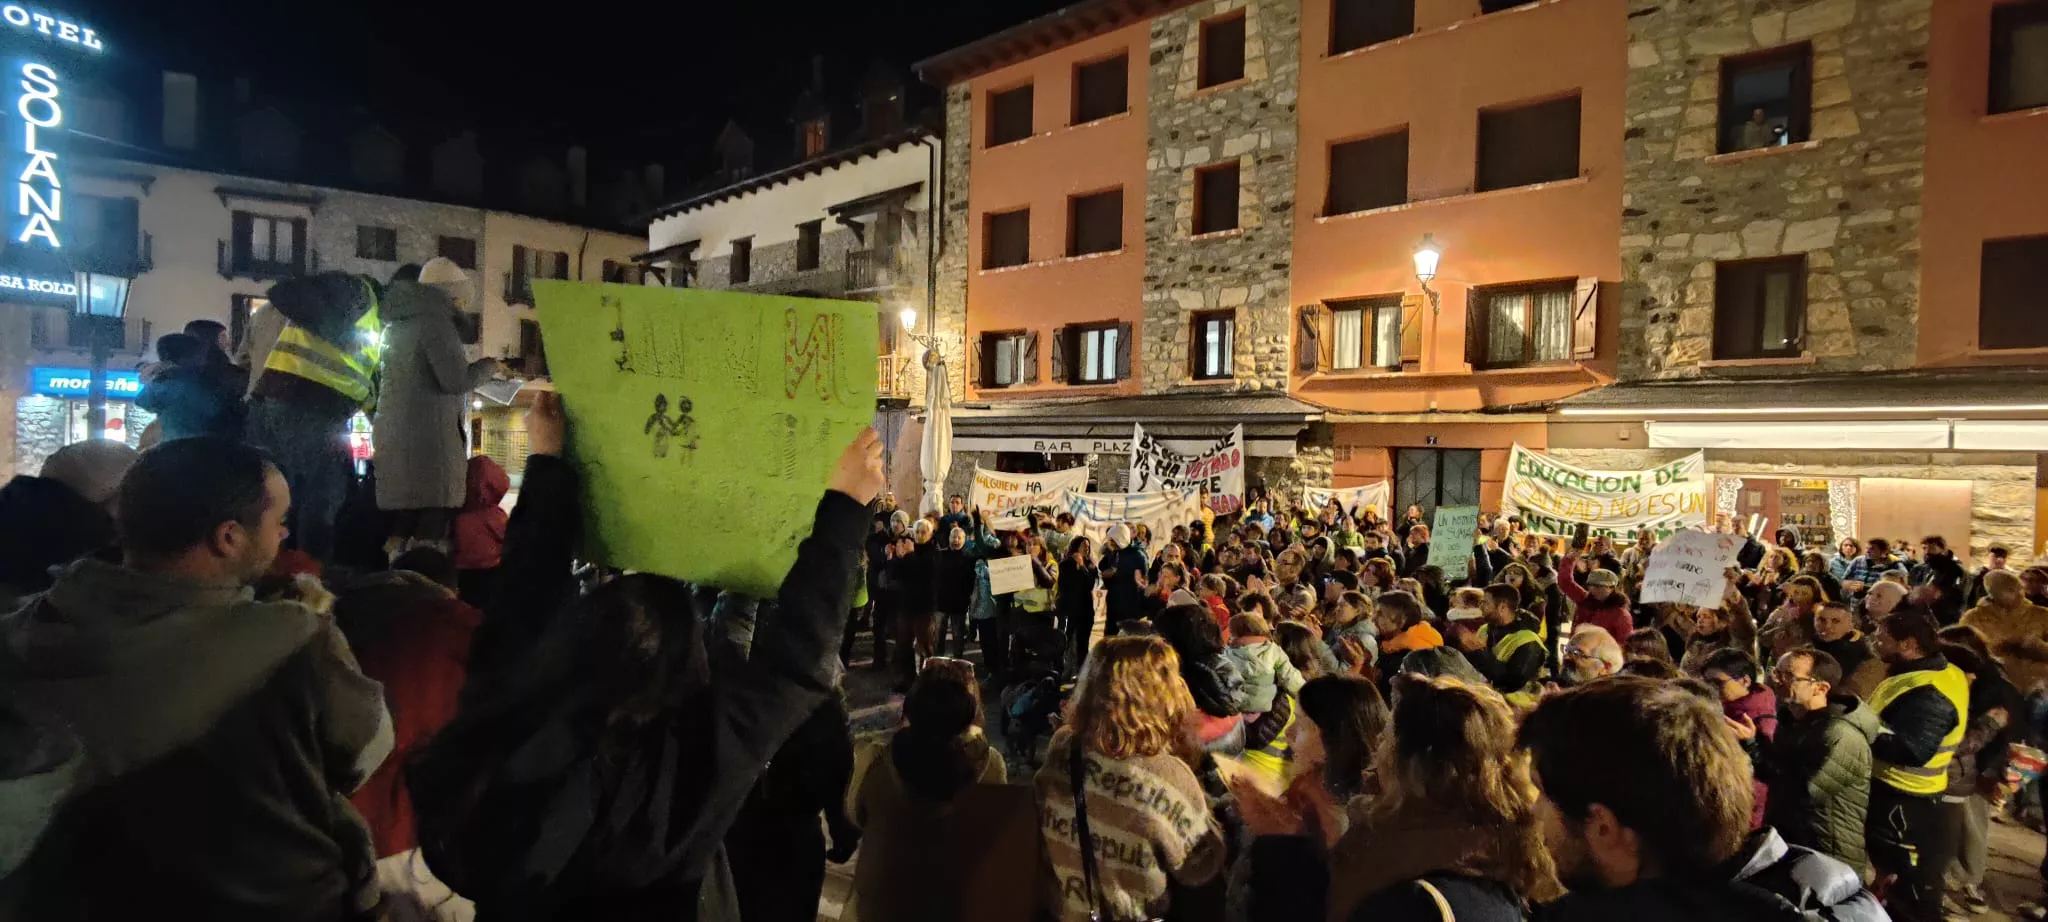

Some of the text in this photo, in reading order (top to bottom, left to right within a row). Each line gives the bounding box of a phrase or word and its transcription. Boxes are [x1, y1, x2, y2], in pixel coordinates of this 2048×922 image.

[3, 5, 103, 50] OTEL
[18, 63, 62, 248] SOLANA
[27, 279, 78, 296] ROLD
[1034, 441, 1131, 452] BAR PLAZ
[1133, 448, 1241, 480] YA HA VOTADO
[1515, 451, 1689, 493] EDUCACION DE
[1025, 481, 1042, 495] HA
[1137, 472, 1150, 492] Y
[1511, 480, 1706, 521] CALIDAD NO ES UN
